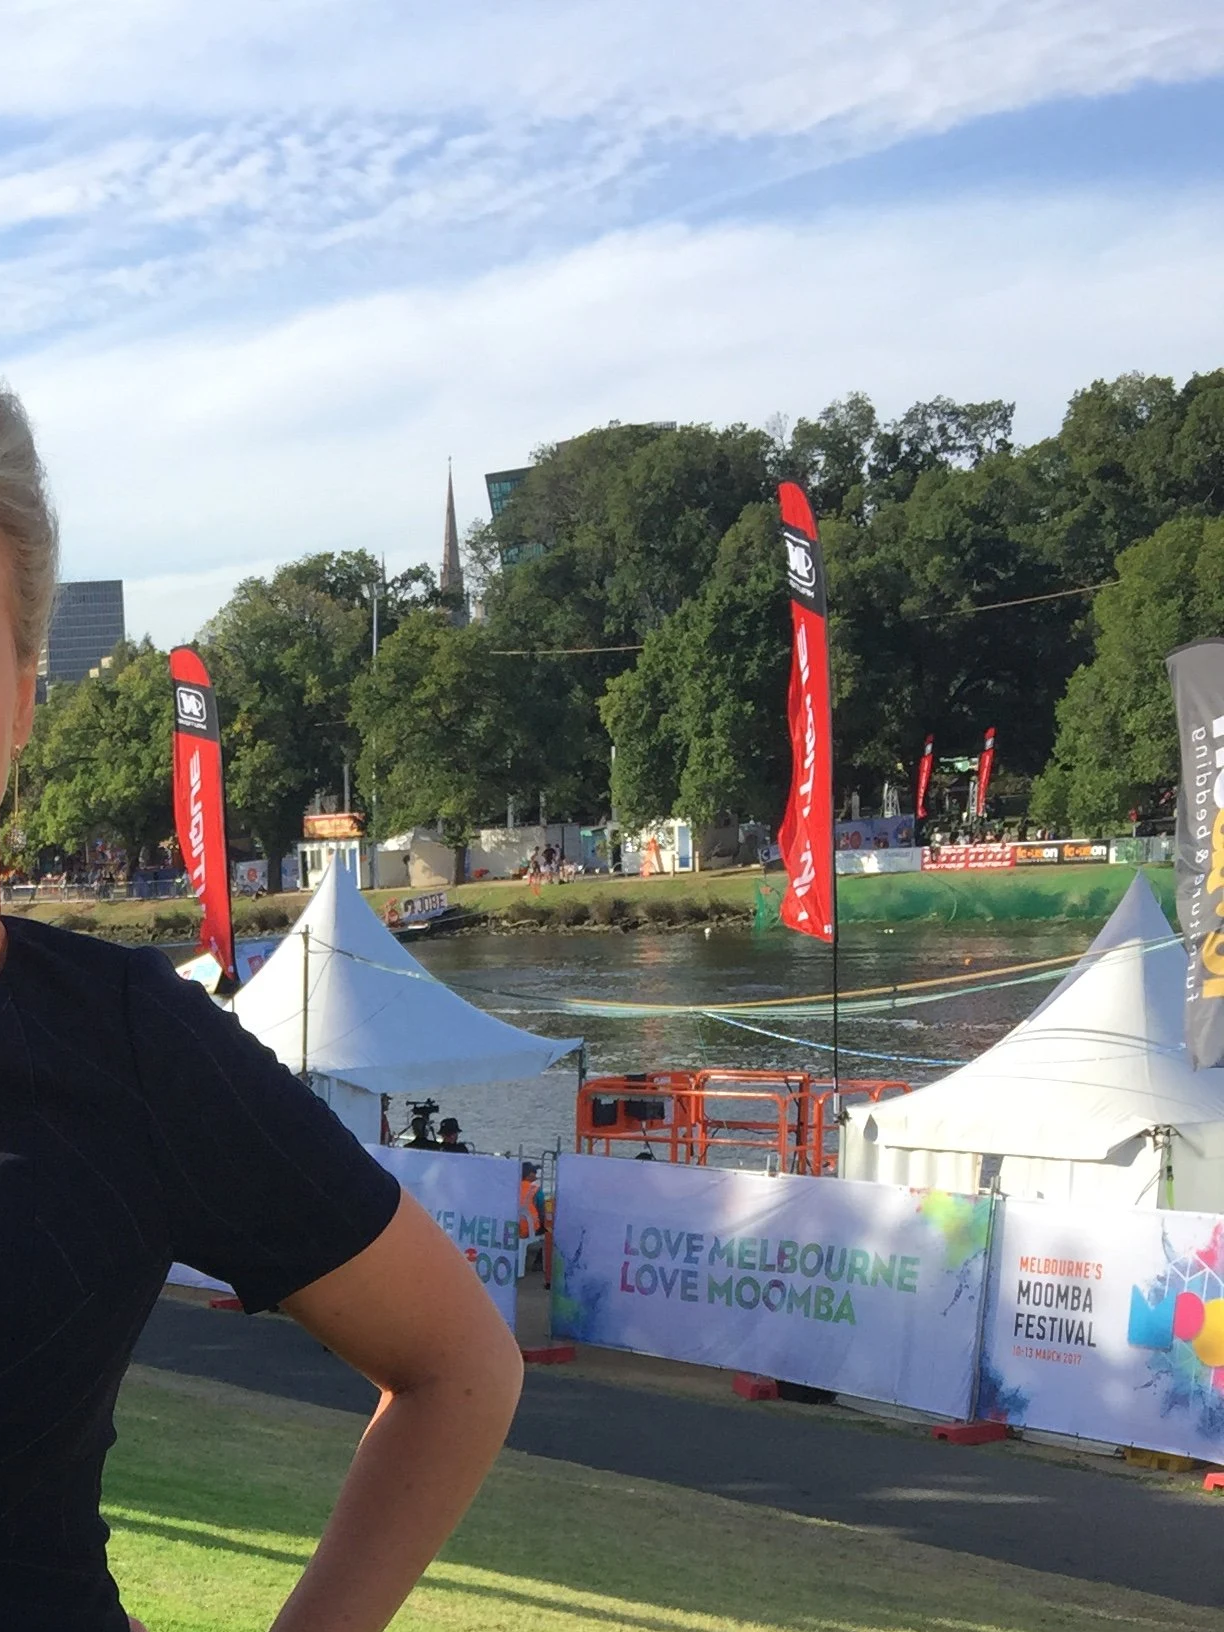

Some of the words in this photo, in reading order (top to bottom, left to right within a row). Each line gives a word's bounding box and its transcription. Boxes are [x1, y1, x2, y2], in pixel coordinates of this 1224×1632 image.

[417, 893, 446, 915] JOBE
[622, 1224, 704, 1265] LOVE
[707, 1235, 921, 1294] MELBOURNE
[1019, 1256, 1104, 1281] MELBOURNE'S
[620, 1260, 699, 1302] LOVE
[707, 1272, 857, 1326] MOOMBA
[1016, 1280, 1094, 1314] MOOMBA
[1013, 1313, 1098, 1348] FESTIVAL
[1035, 1348, 1061, 1362] MARCH
[1063, 1352, 1082, 1365] 2017
